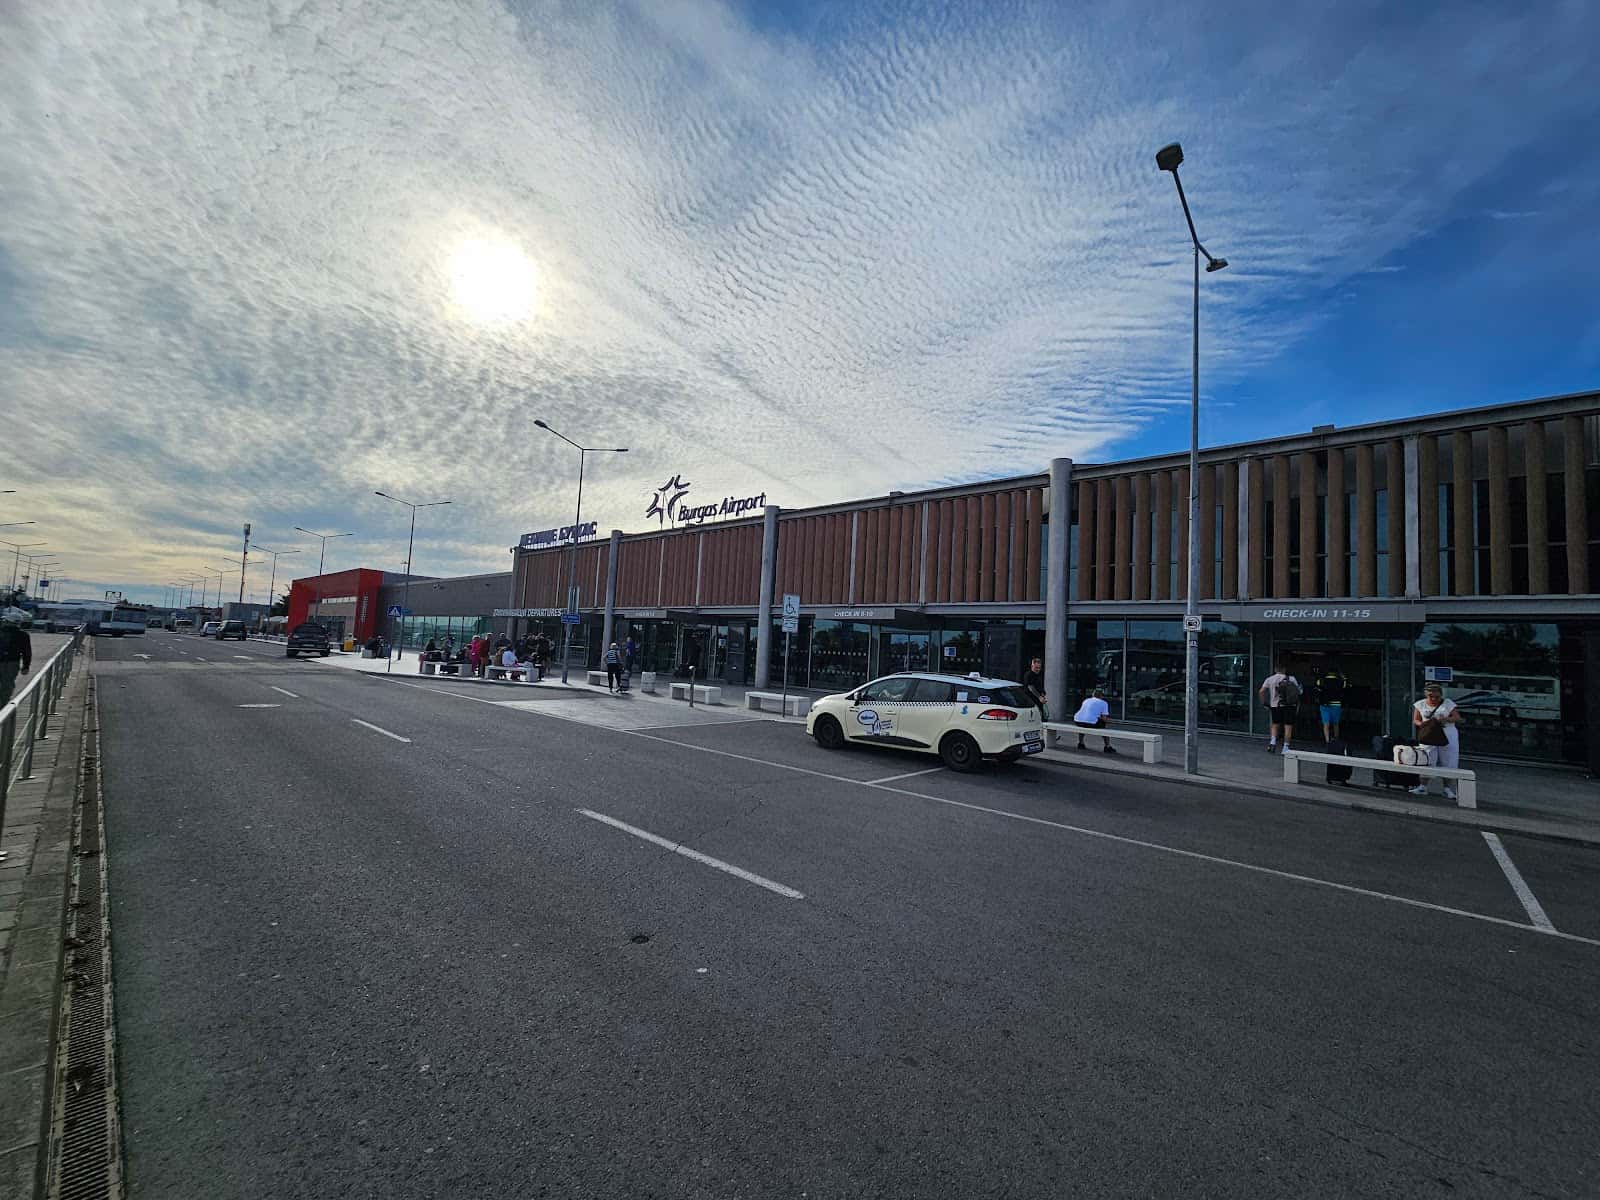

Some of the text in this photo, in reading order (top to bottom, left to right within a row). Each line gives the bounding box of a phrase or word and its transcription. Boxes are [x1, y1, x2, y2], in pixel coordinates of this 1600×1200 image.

[678, 491, 766, 524] Burgas Airport
[526, 608, 562, 617] DEPARTURES
[1263, 609, 1371, 618] CHECK-IN 11-15
